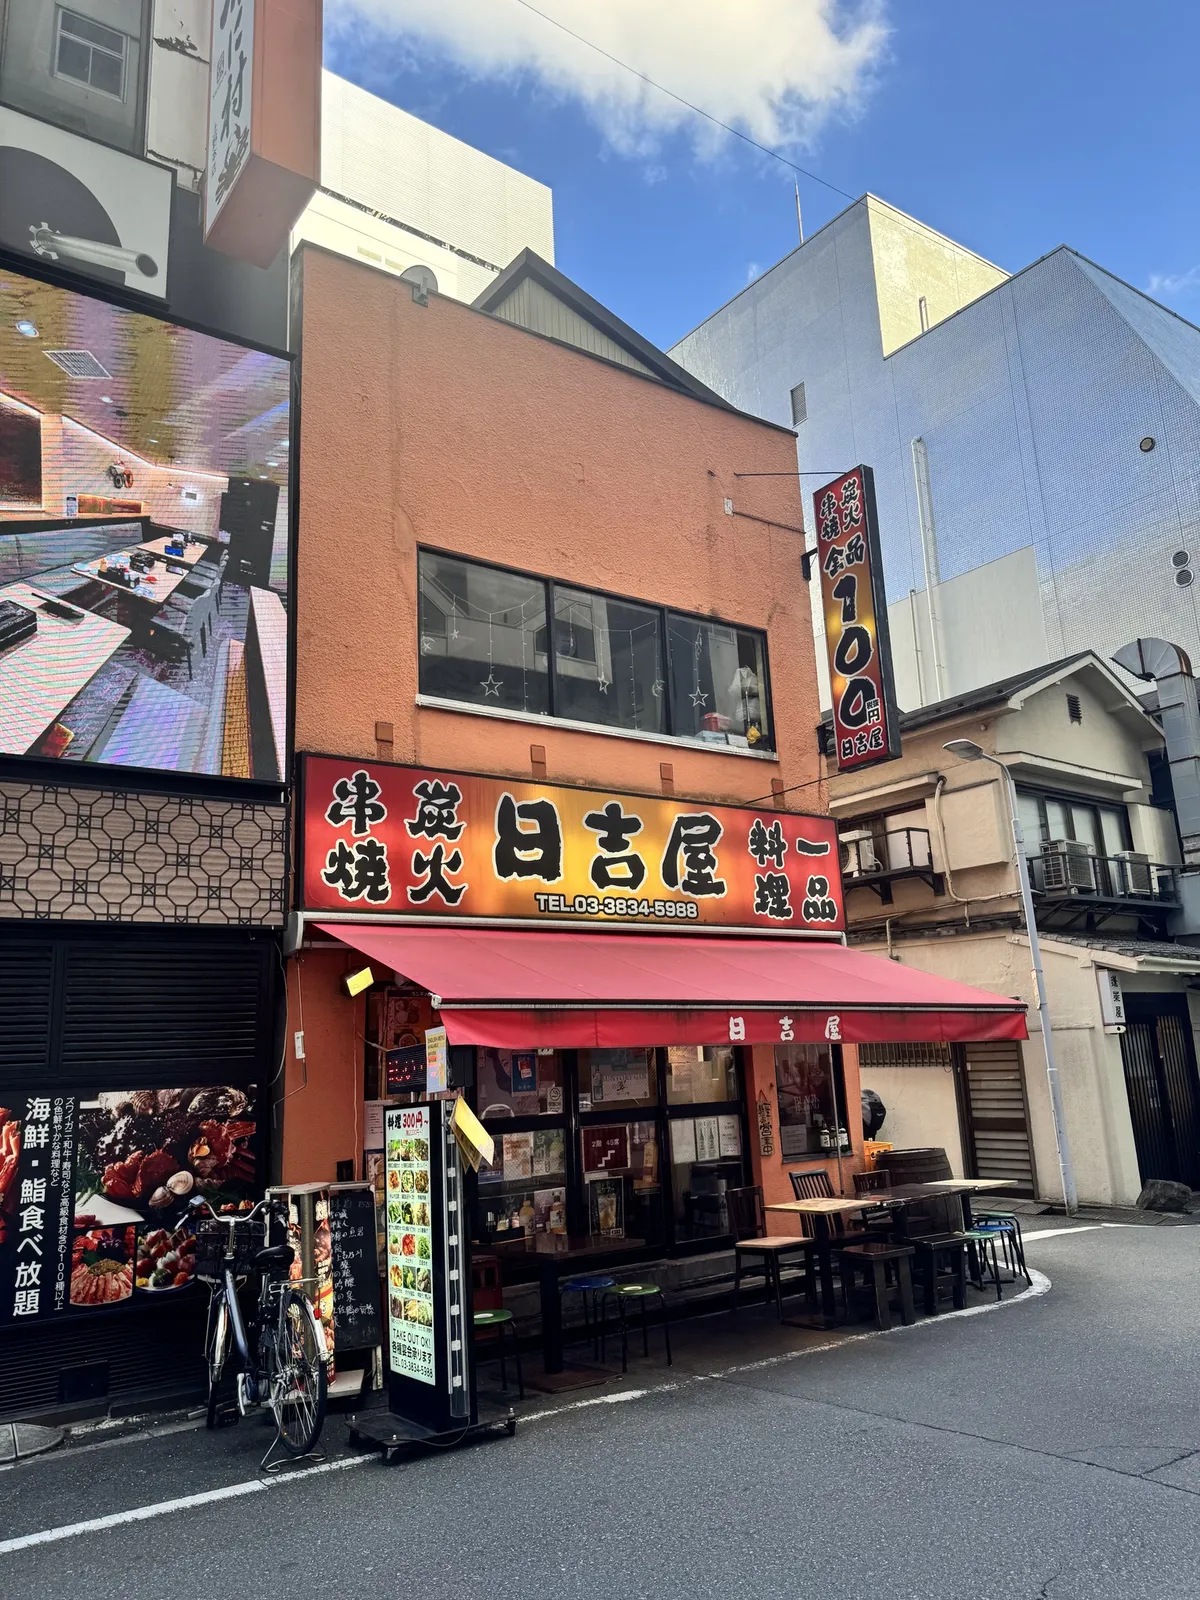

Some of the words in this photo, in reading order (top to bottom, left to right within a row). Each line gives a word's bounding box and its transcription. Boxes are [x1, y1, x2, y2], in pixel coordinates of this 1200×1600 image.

[839, 477, 863, 532] 炭火
[824, 532, 866, 580] 全品
[833, 574, 877, 729] 100
[841, 726, 884, 760] 日吉屋
[403, 779, 469, 906] 炭火
[494, 791, 727, 898] 日吉屋
[748, 818, 793, 920] 料理
[534, 893, 698, 918] TEL.03-3834-5988
[796, 837, 838, 923] 一品
[729, 1015, 842, 1041] 日吉屋
[50, 1097, 63, 1187] の色鮮やかな料理など
[392, 1328, 406, 1342] TAKE
[407, 1332, 419, 1346] OUT
